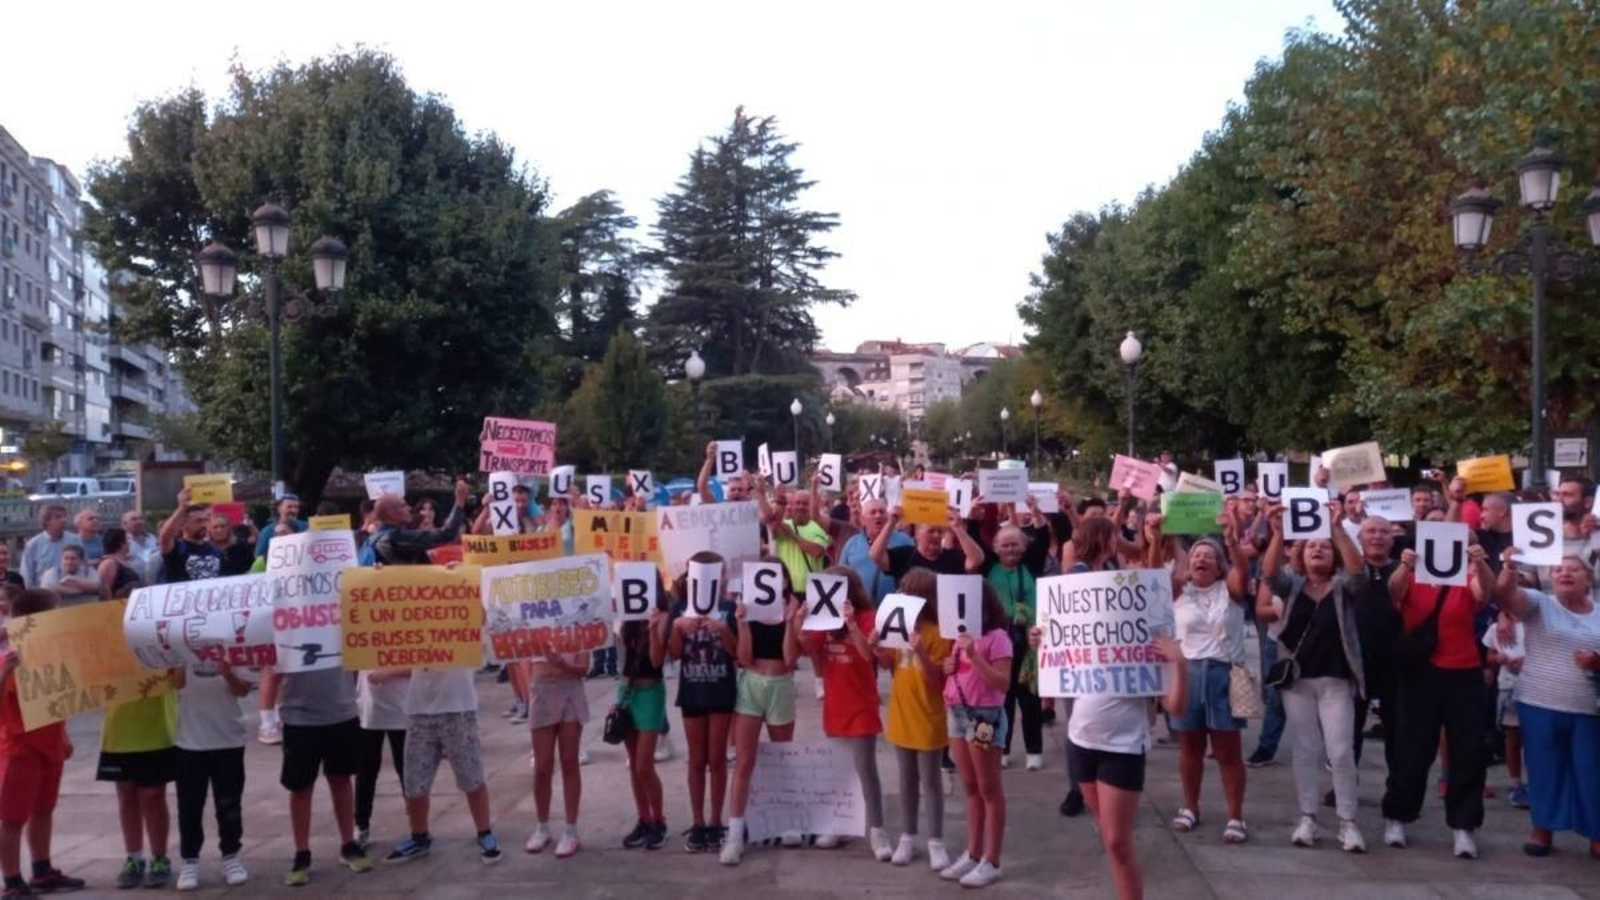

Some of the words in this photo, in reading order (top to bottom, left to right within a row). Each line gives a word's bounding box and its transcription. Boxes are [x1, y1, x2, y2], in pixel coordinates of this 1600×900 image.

[482, 419, 555, 446] NECESITAMOS
[482, 450, 548, 475] TRANSPORTE
[720, 450, 739, 473] B
[776, 461, 796, 485] U
[820, 464, 834, 486] S
[860, 478, 879, 502] X
[493, 481, 510, 501] B
[552, 473, 571, 494] U
[589, 484, 604, 505] S
[633, 473, 651, 494] X
[1220, 469, 1240, 494] B
[1262, 472, 1286, 498] U
[493, 505, 515, 530] X
[660, 511, 674, 531] A
[1289, 497, 1323, 533] B
[1424, 538, 1464, 578] U
[1526, 509, 1556, 549] S
[129, 590, 153, 621] A
[350, 587, 371, 603] SE
[372, 587, 385, 602] A
[387, 579, 481, 602] EDUCACIÓN
[621, 578, 650, 615] B
[692, 578, 719, 616] U
[753, 568, 778, 606] S
[810, 578, 844, 618] X
[879, 606, 910, 643] A
[957, 592, 968, 633] !
[1048, 583, 1148, 614] NUESTROS
[273, 602, 342, 632] OBUSE
[370, 608, 395, 623] UN
[402, 605, 470, 622] DEREITO
[520, 599, 563, 620] PARA
[346, 632, 369, 648] OS
[371, 629, 425, 647] BUSES
[1050, 617, 1149, 648] DERECHOS
[1059, 664, 1163, 695] EXISTEN
